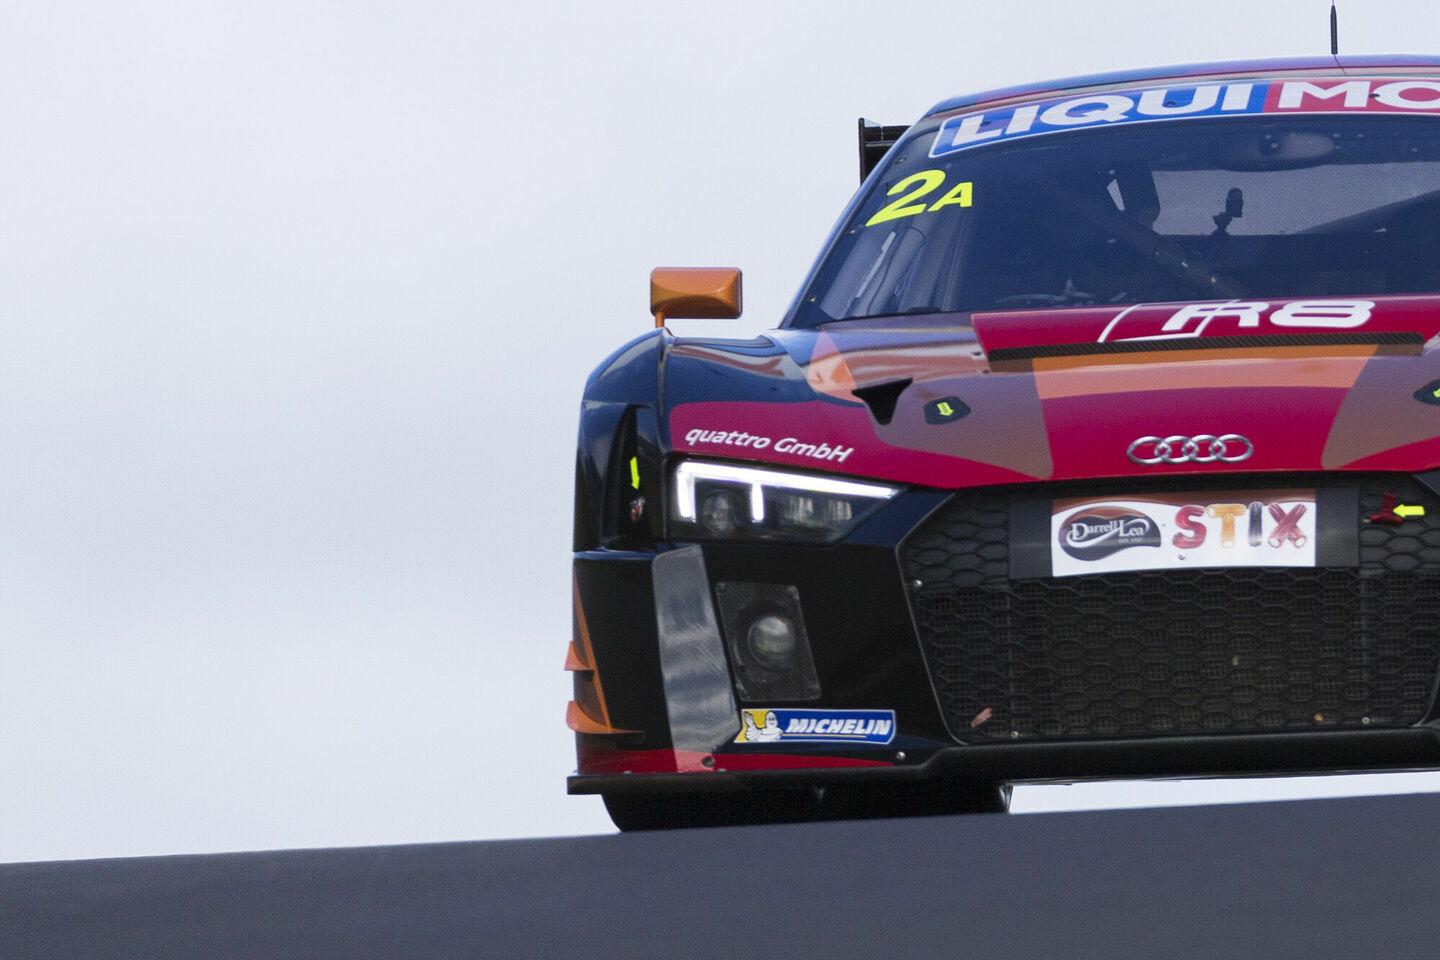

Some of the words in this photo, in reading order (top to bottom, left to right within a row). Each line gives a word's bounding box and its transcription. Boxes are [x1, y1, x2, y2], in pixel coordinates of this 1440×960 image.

[951, 83, 1254, 147] LIQUI
[1161, 300, 1376, 332] R8
[685, 429, 771, 449] quattro
[773, 437, 854, 462] GmbH
[1070, 520, 1118, 541] Darrell
[1118, 519, 1145, 538] Lea
[1172, 501, 1308, 549] STIX
[785, 718, 891, 735] MICHELIN
